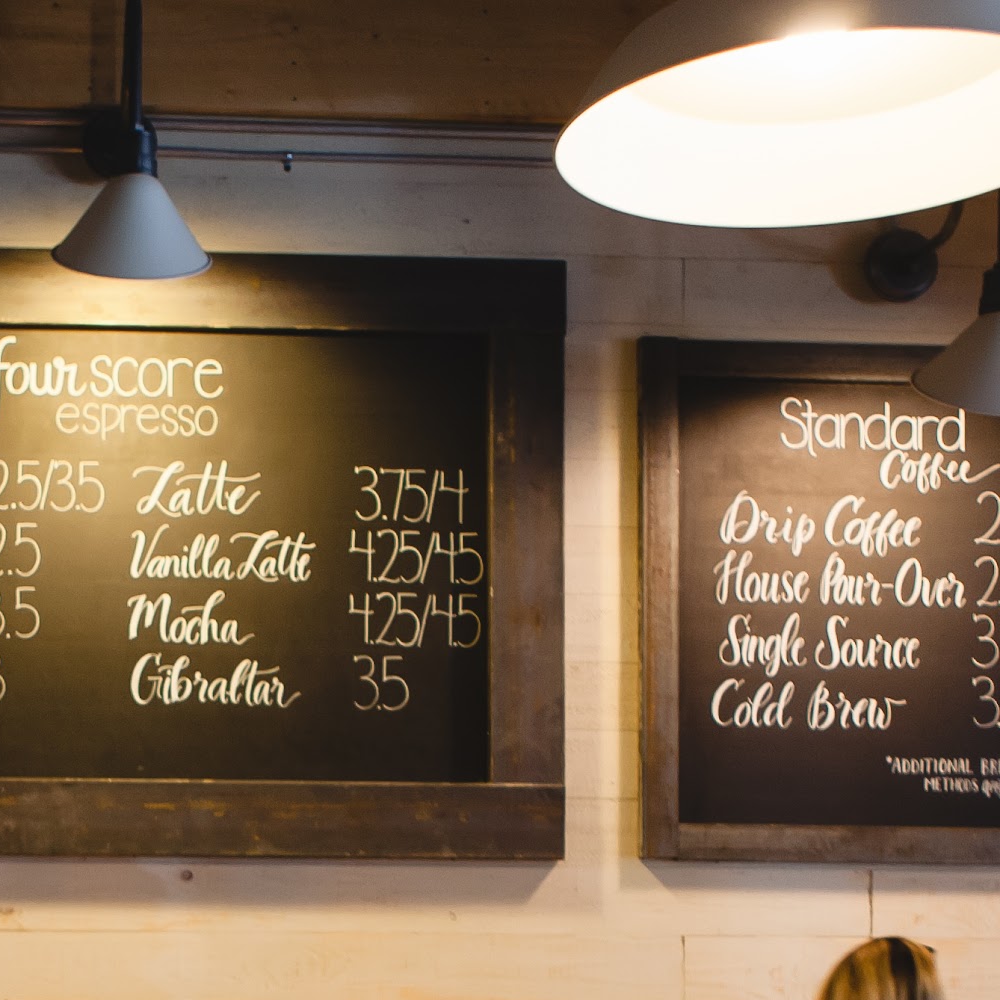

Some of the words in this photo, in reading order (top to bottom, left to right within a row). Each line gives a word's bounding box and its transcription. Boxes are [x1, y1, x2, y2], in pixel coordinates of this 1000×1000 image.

[90, 355, 224, 399] score
[55, 402, 219, 441] espresso
[779, 396, 966, 457] Standard
[132, 459, 262, 518] Latte
[879, 448, 1000, 494] Coffee
[718, 490, 816, 557] Drip
[824, 494, 922, 557] Coffee
[130, 523, 236, 583] Vanilla
[230, 529, 317, 583] Latte
[713, 549, 810, 605] House
[127, 589, 255, 645] Mocha
[718, 612, 807, 677] Single
[814, 614, 921, 670] Source
[130, 652, 301, 709] Gibraltar
[352, 654, 410, 711] 3.5
[711, 678, 795, 730] Cold
[806, 680, 907, 730] Brew
